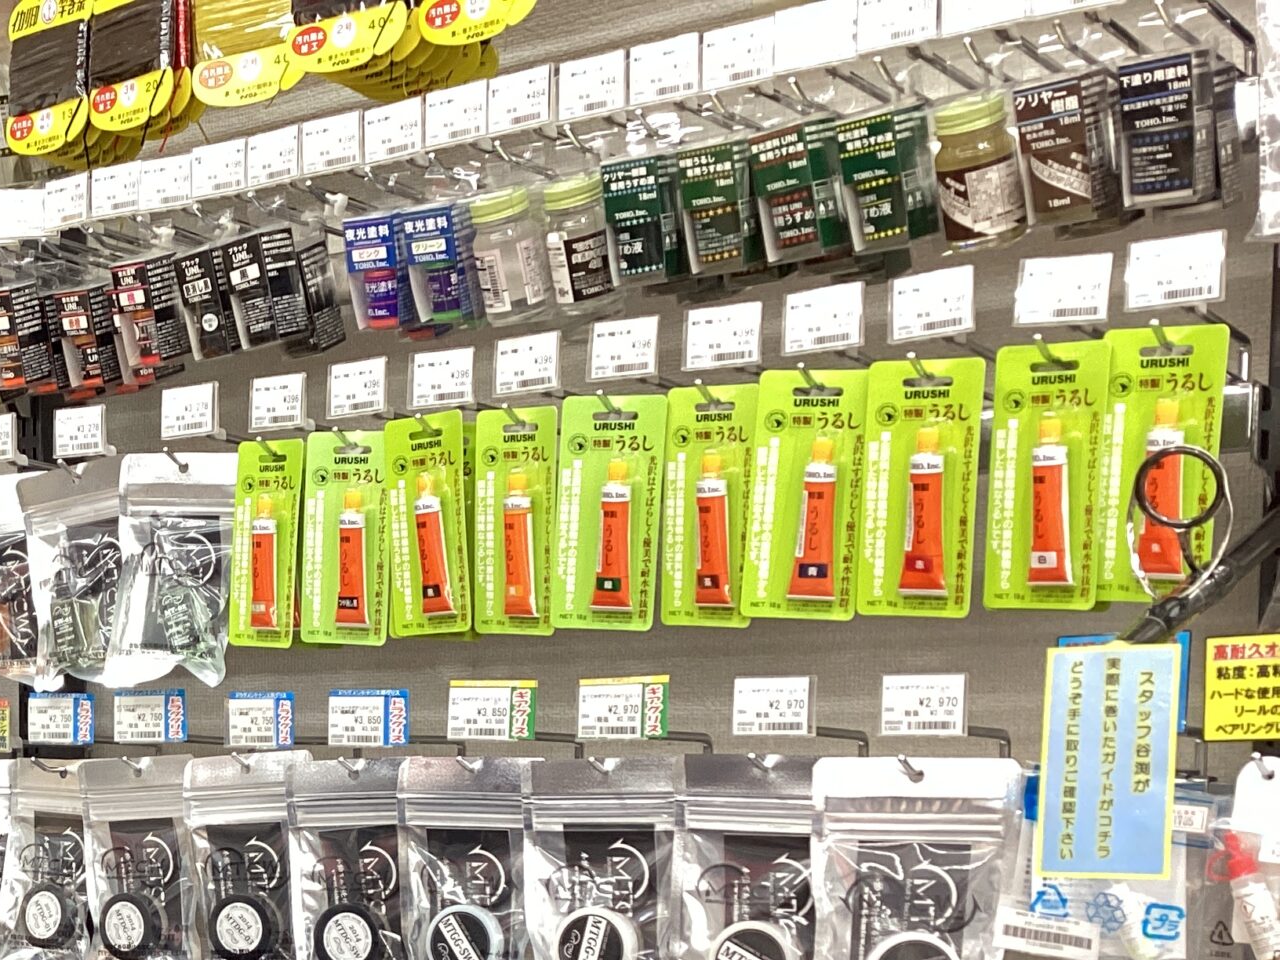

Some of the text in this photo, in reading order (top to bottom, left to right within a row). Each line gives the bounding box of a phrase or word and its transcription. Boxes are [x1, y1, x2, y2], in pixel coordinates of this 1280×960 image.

[1120, 65, 1189, 89] 下塗り用塗料
[1168, 79, 1191, 91] 18ml
[1015, 90, 1067, 110] クリヤー
[1059, 114, 1081, 126] 18ml
[1048, 197, 1071, 209] 18ml
[345, 224, 389, 241] 夜光塗料
[404, 216, 448, 234] 夜光塗料
[228, 243, 248, 254] ブラック
[358, 249, 380, 261] ピンク
[413, 240, 444, 252] グリーン
[1141, 356, 1189, 369] URUSHI
[1032, 373, 1076, 386] URUSHI
[1139, 372, 1213, 392] 特製 うるし
[794, 398, 839, 408] URUSHI
[905, 389, 950, 400] URUSHI
[1032, 387, 1097, 407] 特製 うるし
[696, 412, 732, 423] URUSHI
[928, 402, 970, 421] うるし
[594, 422, 635, 431] URUSHI
[818, 412, 861, 431] うるし
[504, 433, 536, 444] URUSHI
[616, 434, 655, 452] うるし
[716, 425, 749, 444] うるし
[411, 440, 442, 452] URUSHI
[522, 445, 550, 463] うるし
[334, 456, 368, 465] URUSHI
[429, 449, 456, 467] うるし
[259, 464, 285, 473] URUSHI
[352, 467, 384, 485] うるし
[273, 475, 297, 491] うるし
[1213, 642, 1280, 661] 高耐久オ
[514, 689, 530, 738] ギアグリス
[646, 684, 665, 737] ギアグリス
[390, 698, 406, 744] ドラググリス
[1132, 670, 1155, 794] スタッフ谷渕が
[1059, 660, 1084, 861] どうぞ手に取りご確認下さい
[1098, 657, 1122, 859] 実際に巻いたガイドがコチラ
[223, 913, 255, 946] MTDG-03
[333, 918, 363, 960] MTDG-SW
